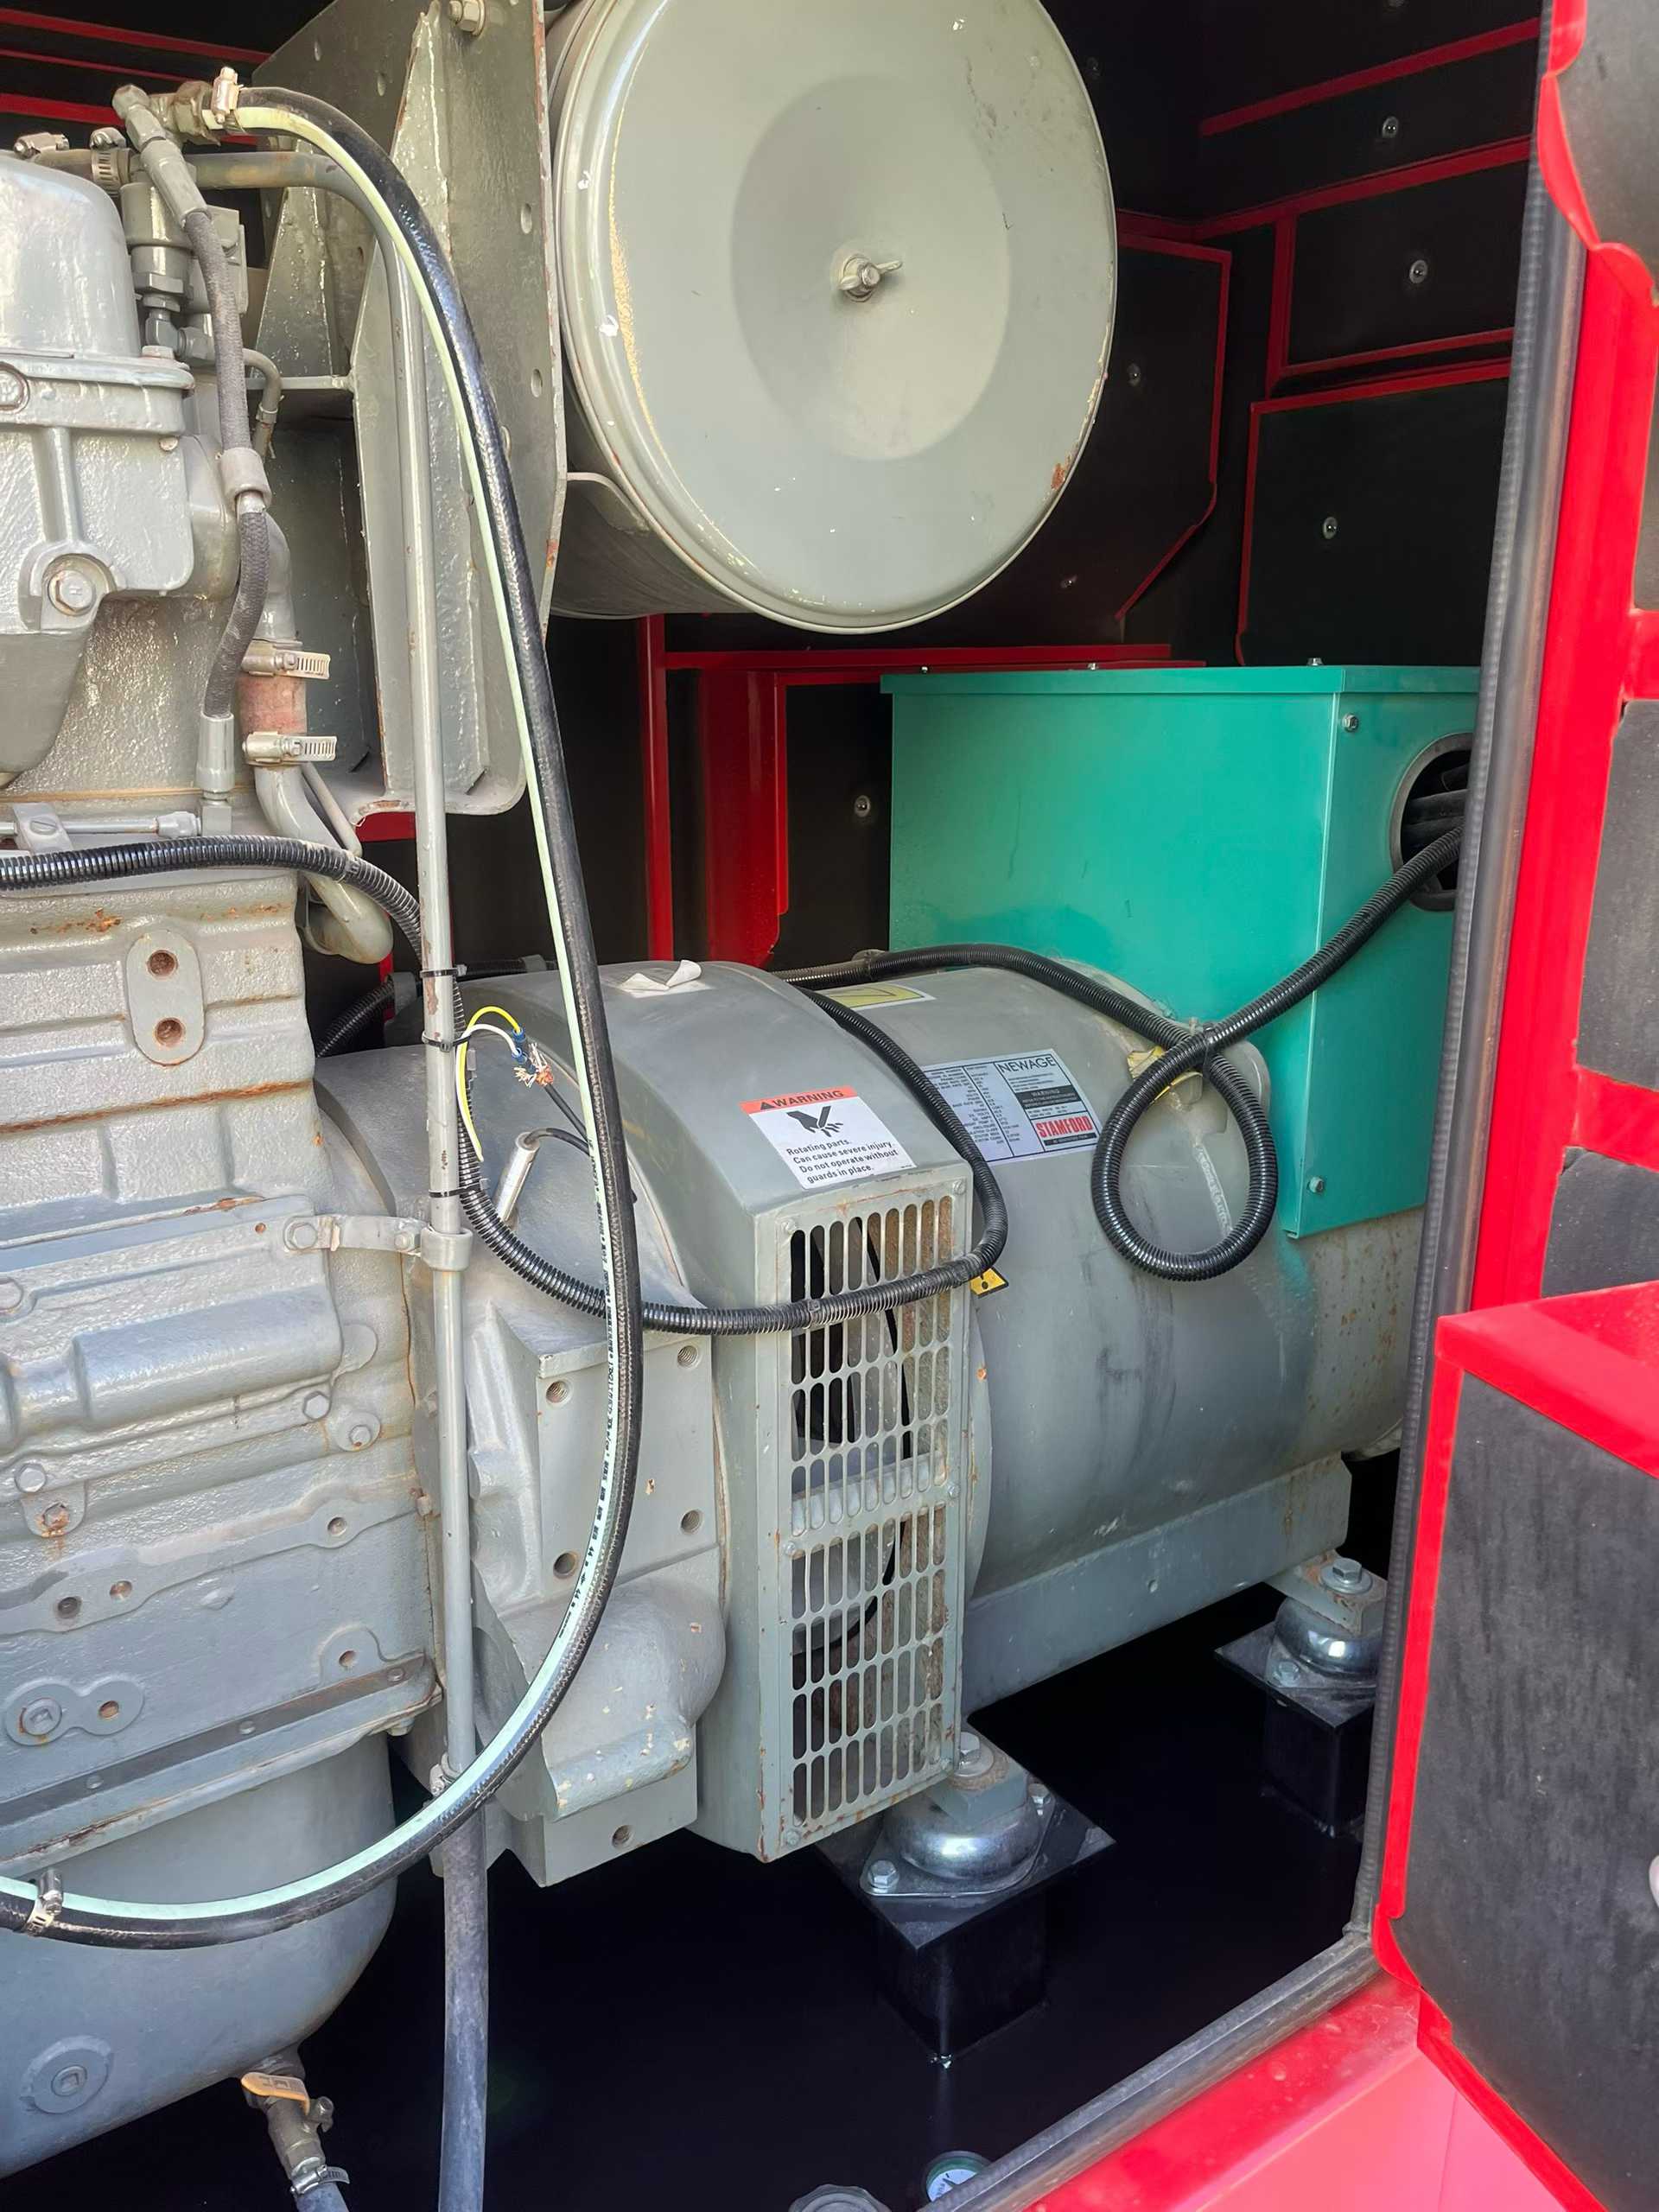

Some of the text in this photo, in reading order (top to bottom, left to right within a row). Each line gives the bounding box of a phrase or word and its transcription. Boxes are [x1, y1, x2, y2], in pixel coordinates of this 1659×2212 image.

[997, 1056, 1056, 1073] NEWAGE
[772, 1090, 844, 1107] WARNING
[1035, 1116, 1093, 1137] STAMFORD
[785, 1142, 827, 1156] Rotating
[793, 1155, 811, 1165] Can
[813, 1150, 838, 1161] cause
[838, 1145, 868, 1156] severe
[798, 1148, 899, 1174] Do not operate without
[806, 1170, 839, 1185] guards
[838, 1167, 848, 1177] in
